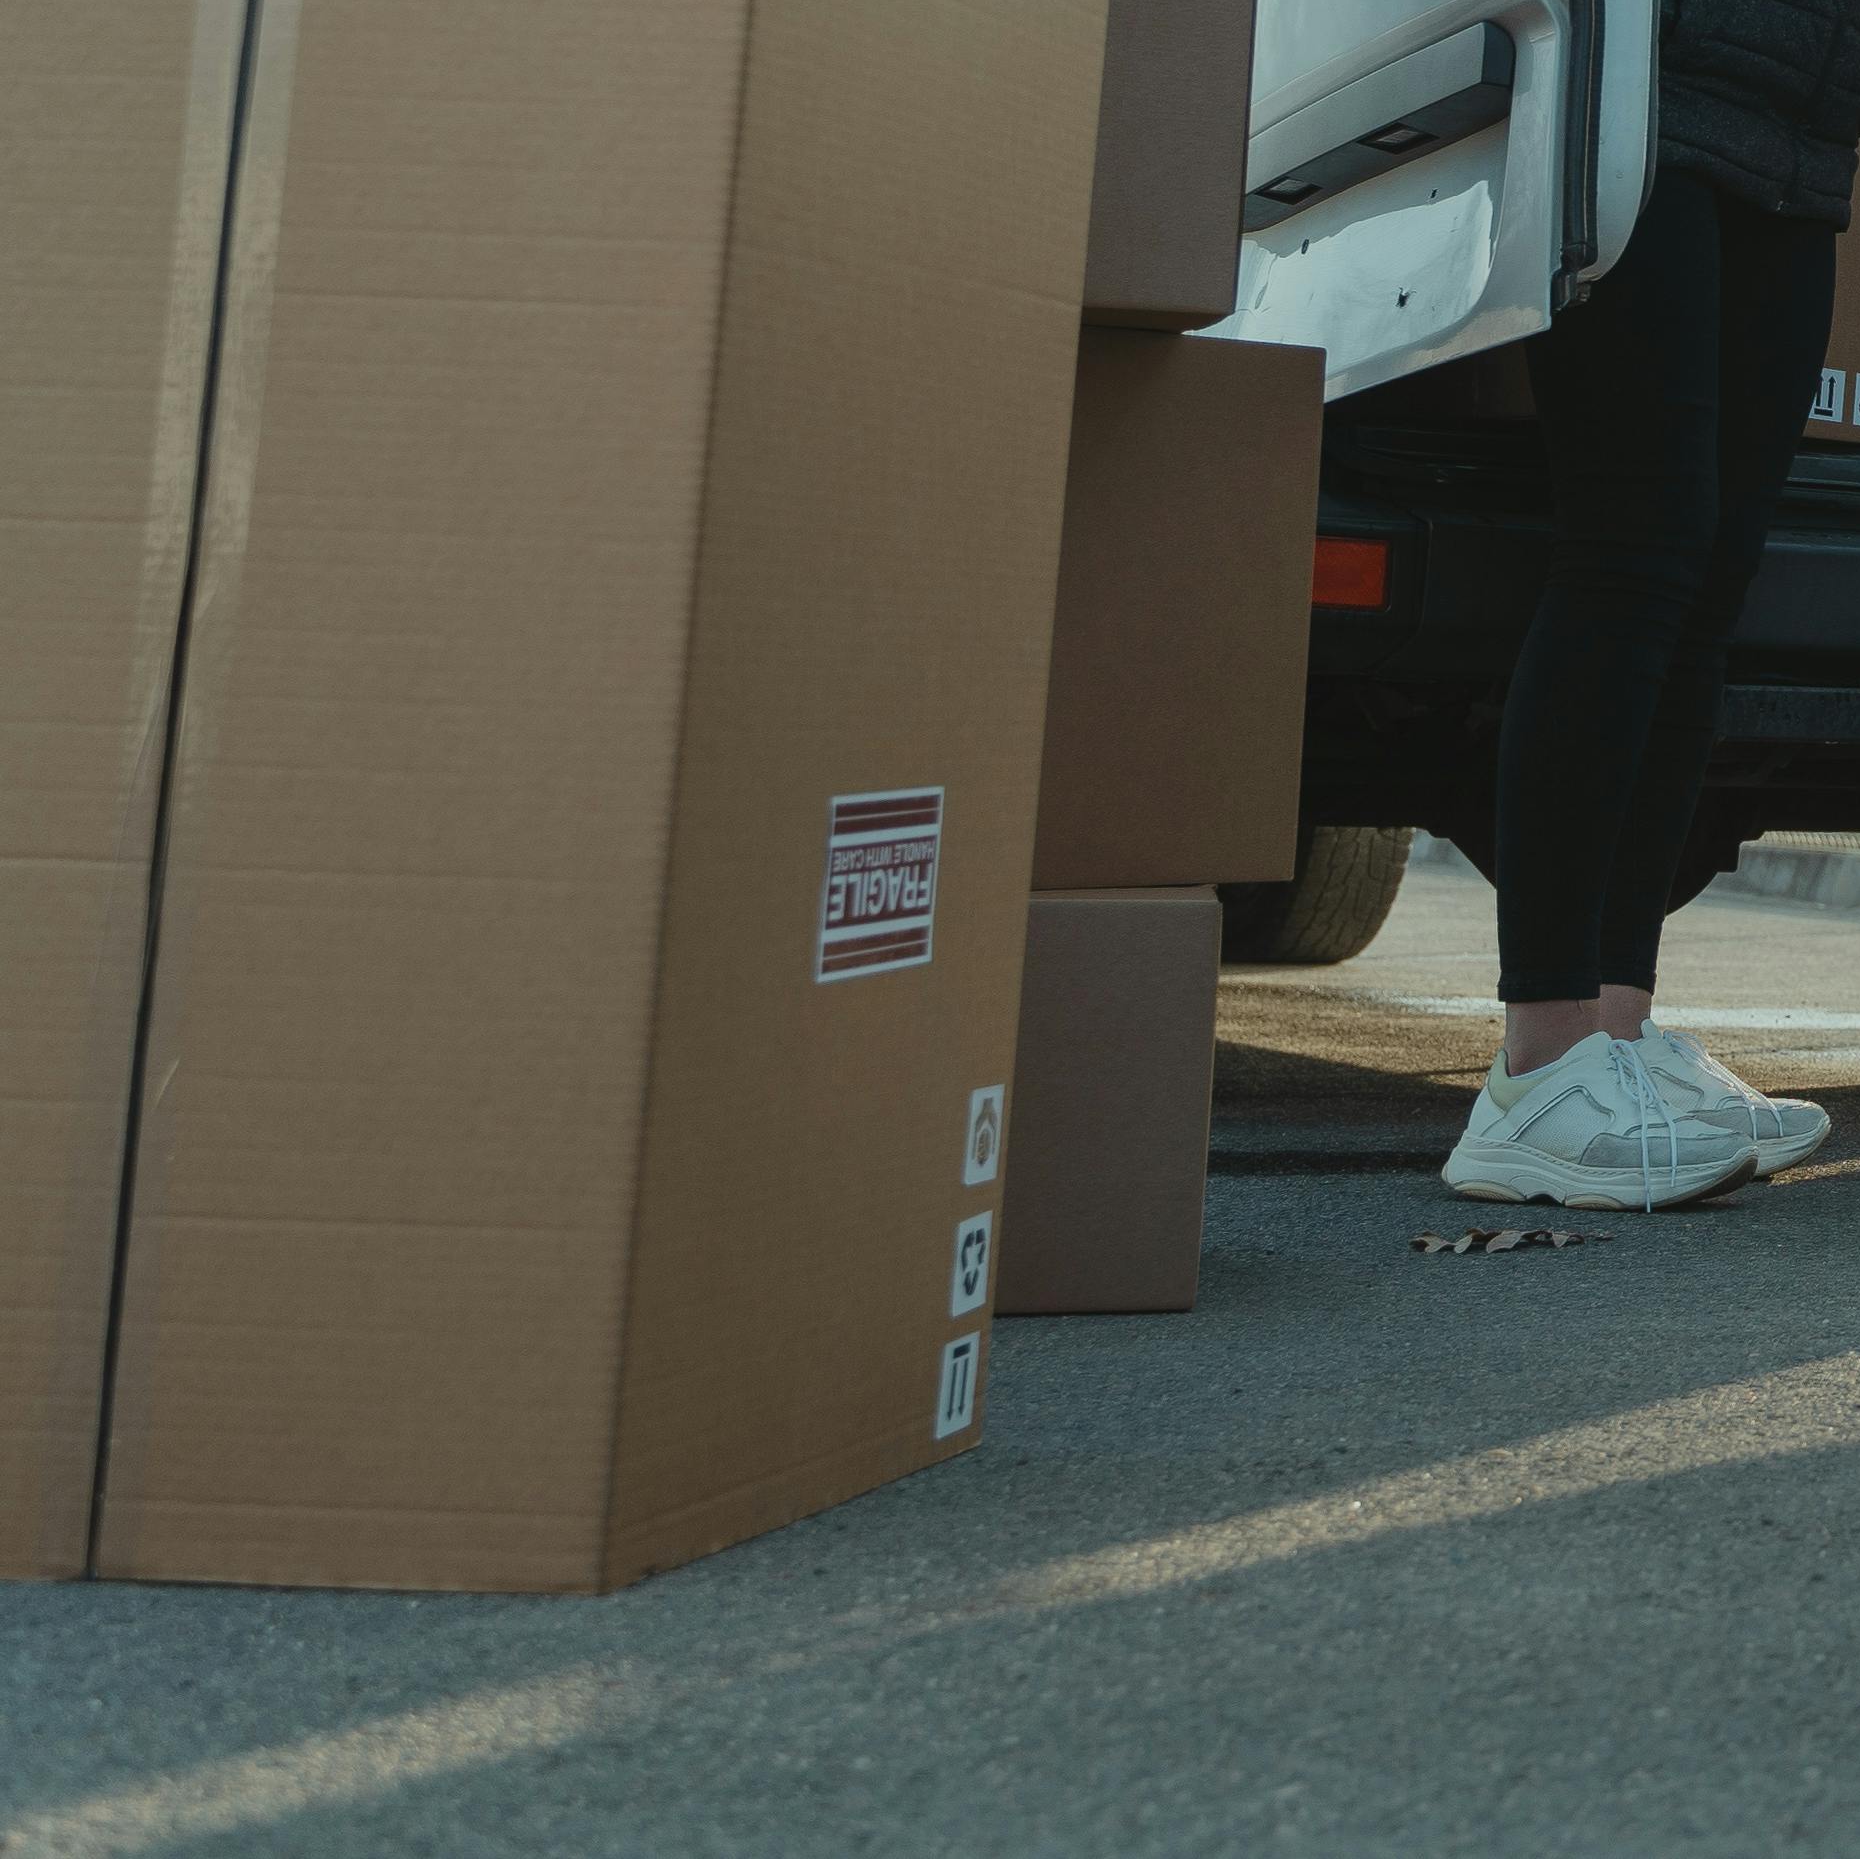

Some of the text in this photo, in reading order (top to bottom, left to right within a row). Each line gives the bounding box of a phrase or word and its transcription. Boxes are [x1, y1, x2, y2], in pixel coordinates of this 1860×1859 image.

[833, 840, 936, 870] HANDLE WITH CARE
[828, 863, 933, 921] FRAGILE
